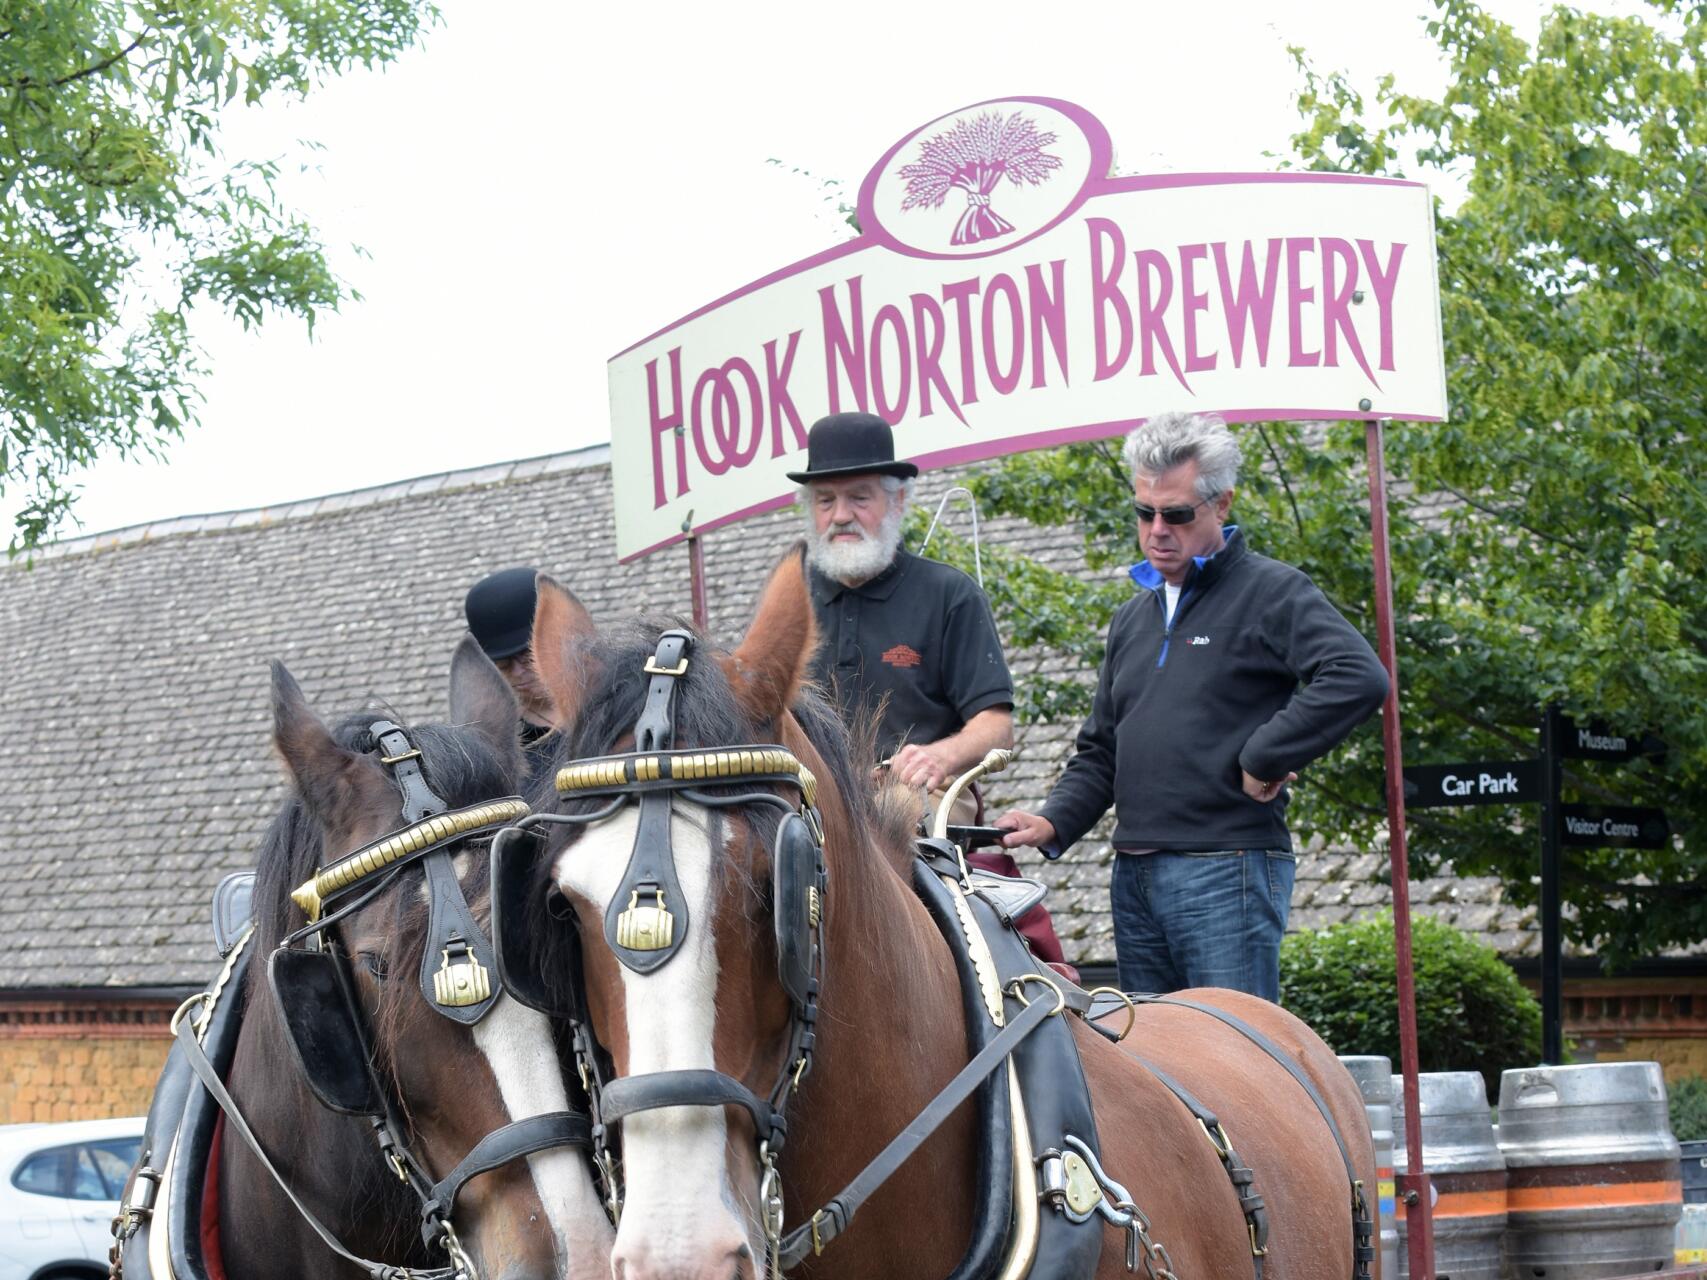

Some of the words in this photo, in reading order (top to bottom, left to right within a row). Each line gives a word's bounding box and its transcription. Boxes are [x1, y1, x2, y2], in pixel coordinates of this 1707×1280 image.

[645, 328, 809, 510] HOOK
[817, 259, 1069, 429] NORTON
[1085, 217, 1408, 396] BREWERY
[1579, 729, 1627, 751] Museum
[1441, 774, 1475, 796] Car
[1479, 771, 1519, 794] Park
[1565, 816, 1600, 835] Visitor
[1602, 818, 1639, 837] Centre
